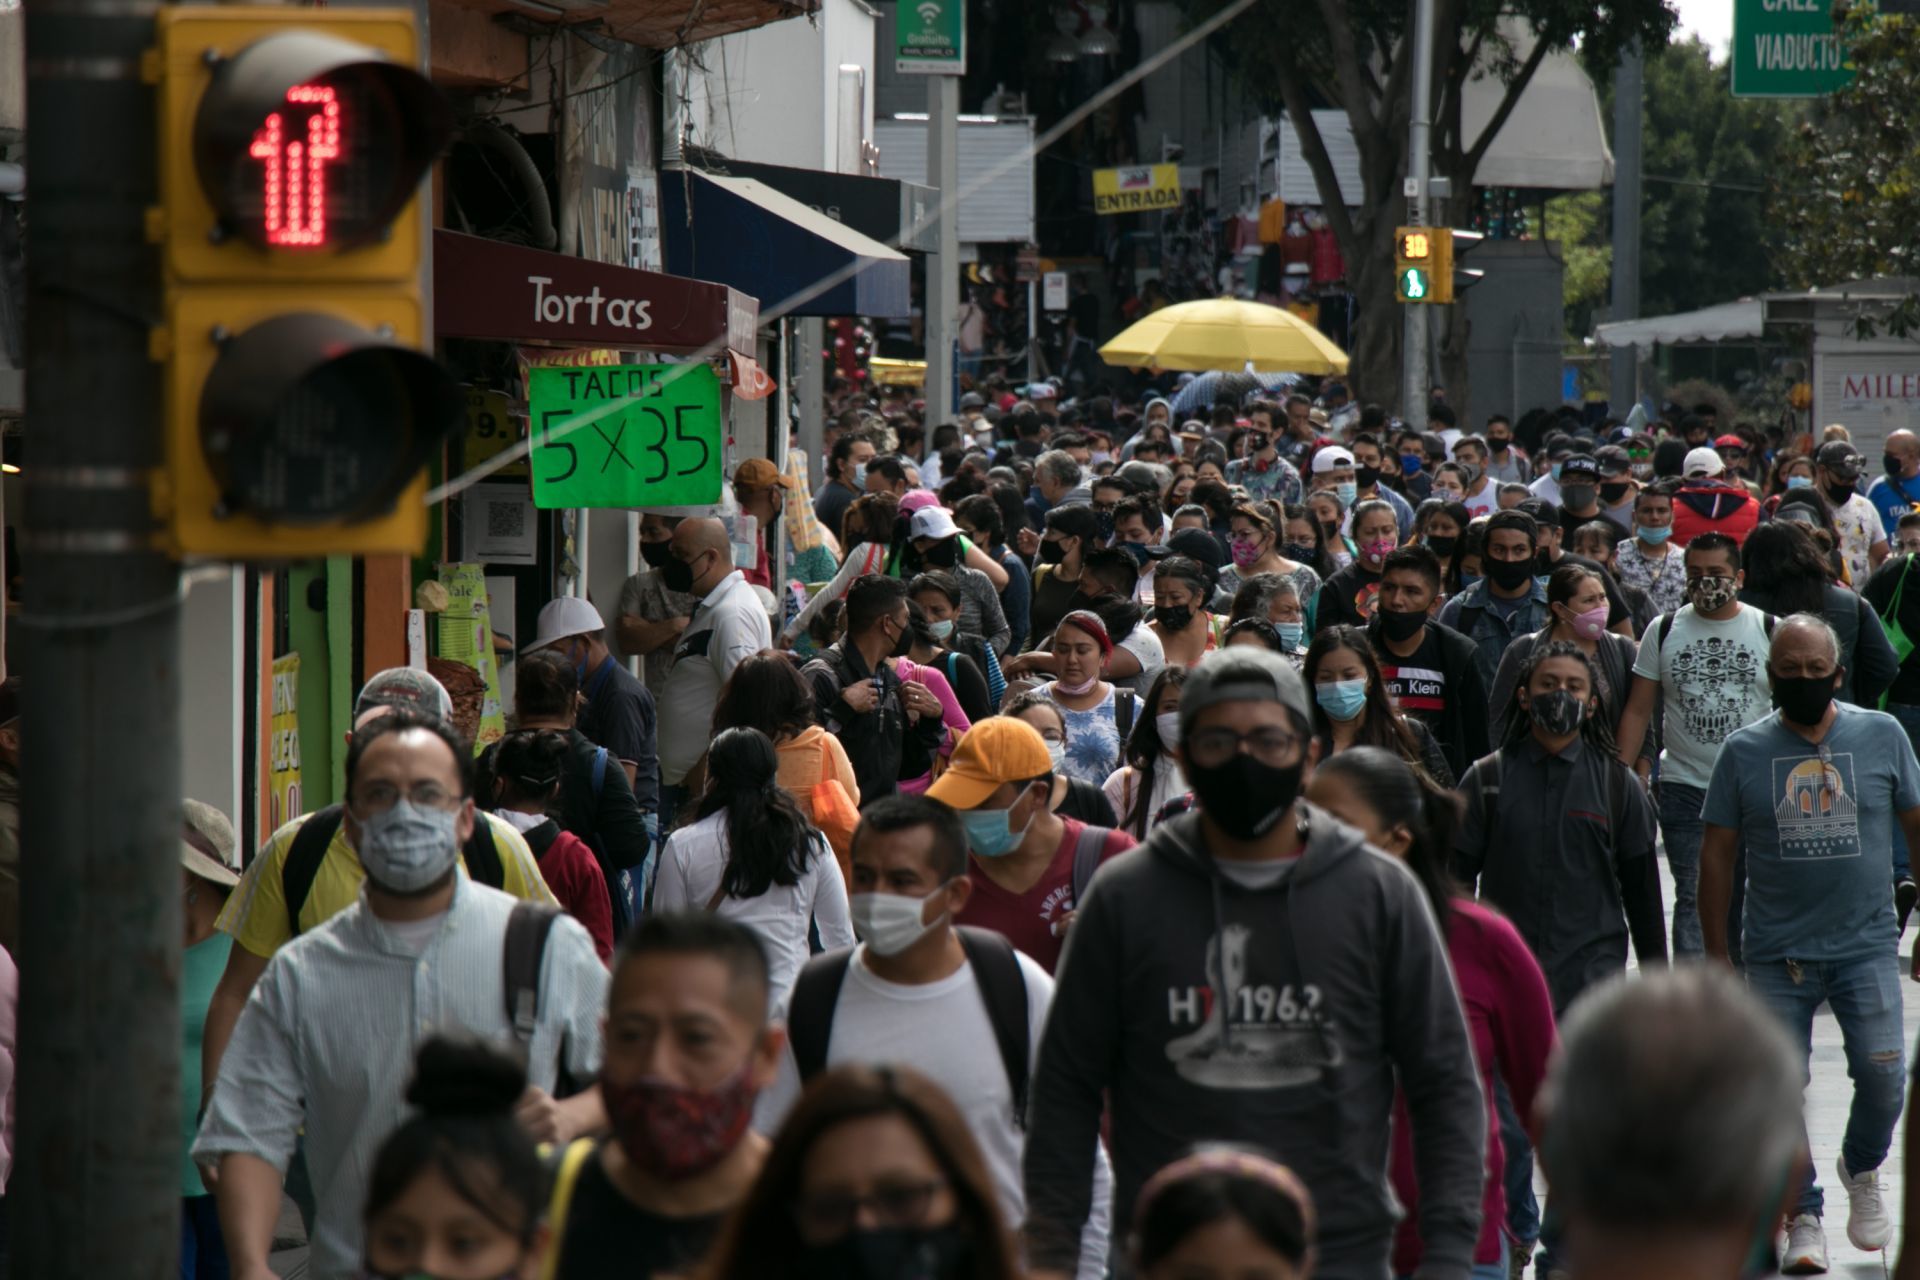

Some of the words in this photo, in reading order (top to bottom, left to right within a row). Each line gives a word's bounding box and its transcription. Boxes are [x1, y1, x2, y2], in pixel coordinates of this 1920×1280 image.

[1754, 33, 1841, 71] VIADUCTO
[1096, 187, 1180, 211] ENTRADA
[528, 276, 653, 330] Tortas
[561, 369, 663, 400] TACOS
[541, 409, 578, 484] 5
[641, 405, 709, 484] 35
[1408, 679, 1440, 695] Klein
[1786, 838, 1854, 849] BROOKLYN
[1807, 847, 1832, 856] NYC
